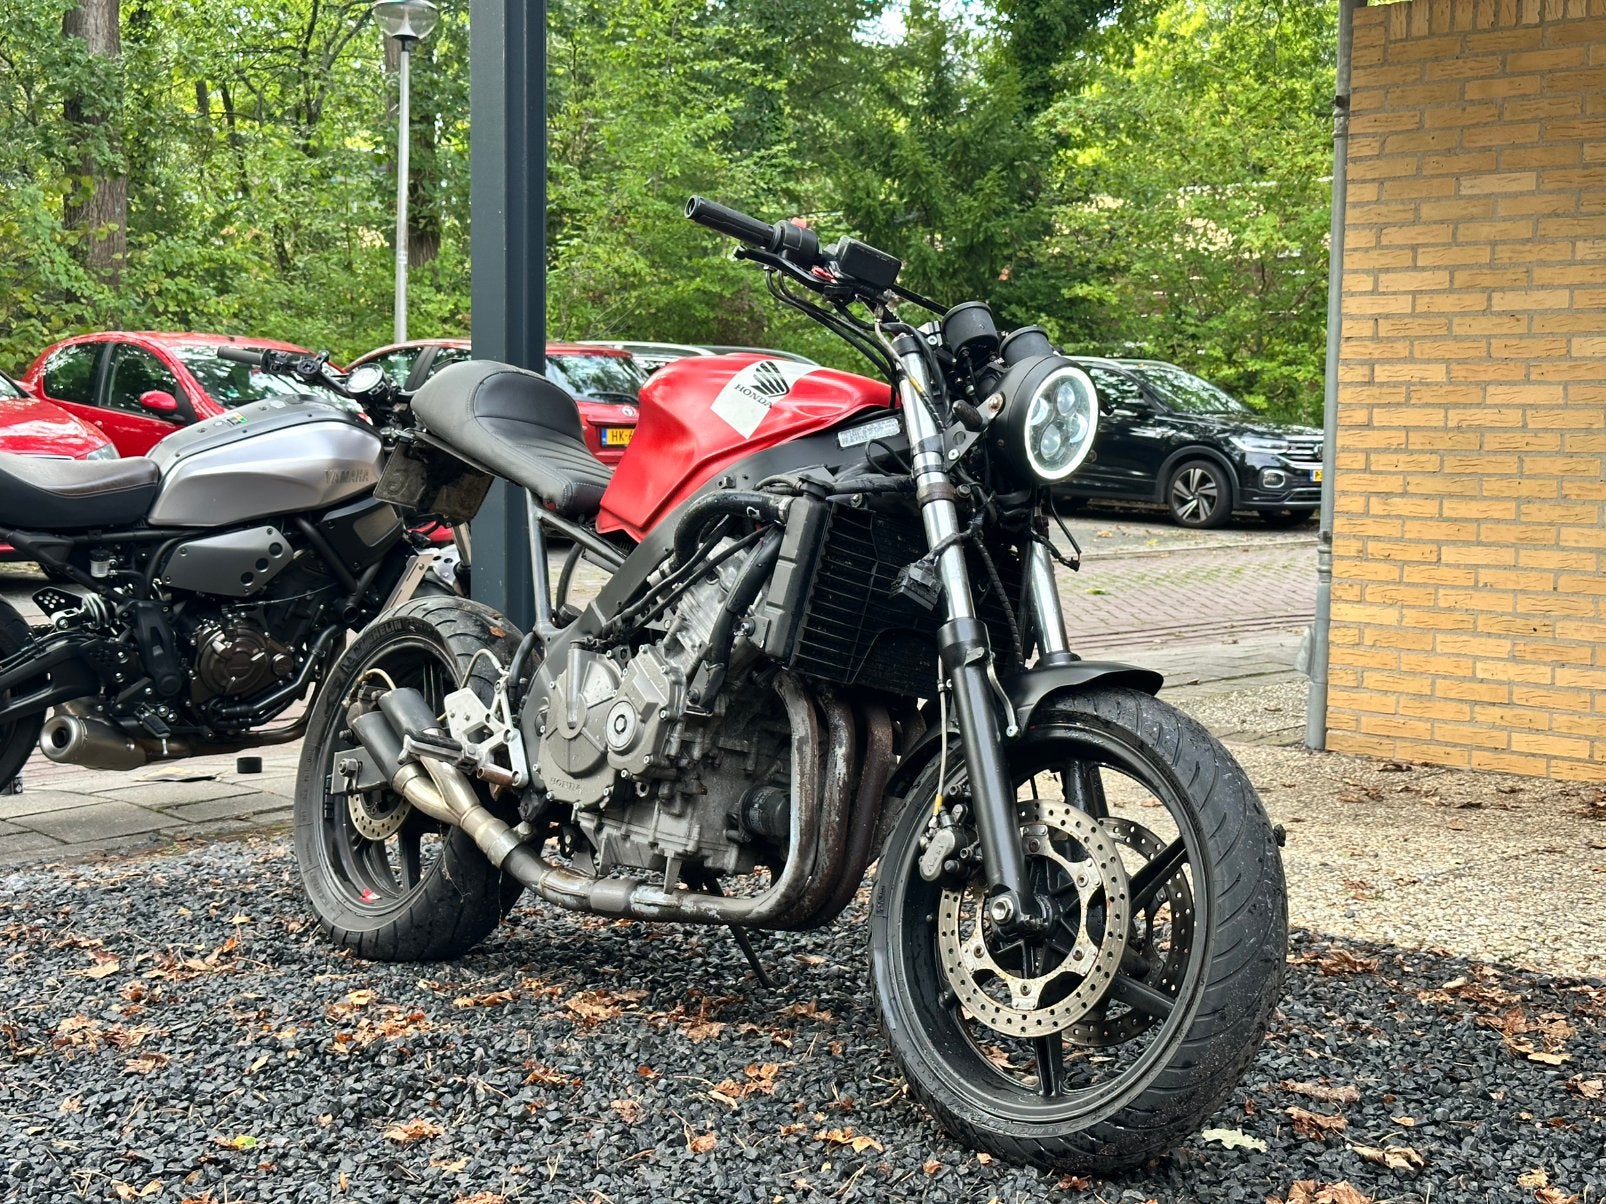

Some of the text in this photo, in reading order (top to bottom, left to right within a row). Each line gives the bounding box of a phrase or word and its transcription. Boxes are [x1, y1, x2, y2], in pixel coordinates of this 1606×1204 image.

[734, 384, 772, 409] HONDA
[323, 469, 370, 484] YAMAHA
[359, 619, 403, 652] MICHELIN
[551, 776, 583, 794] HONDA
